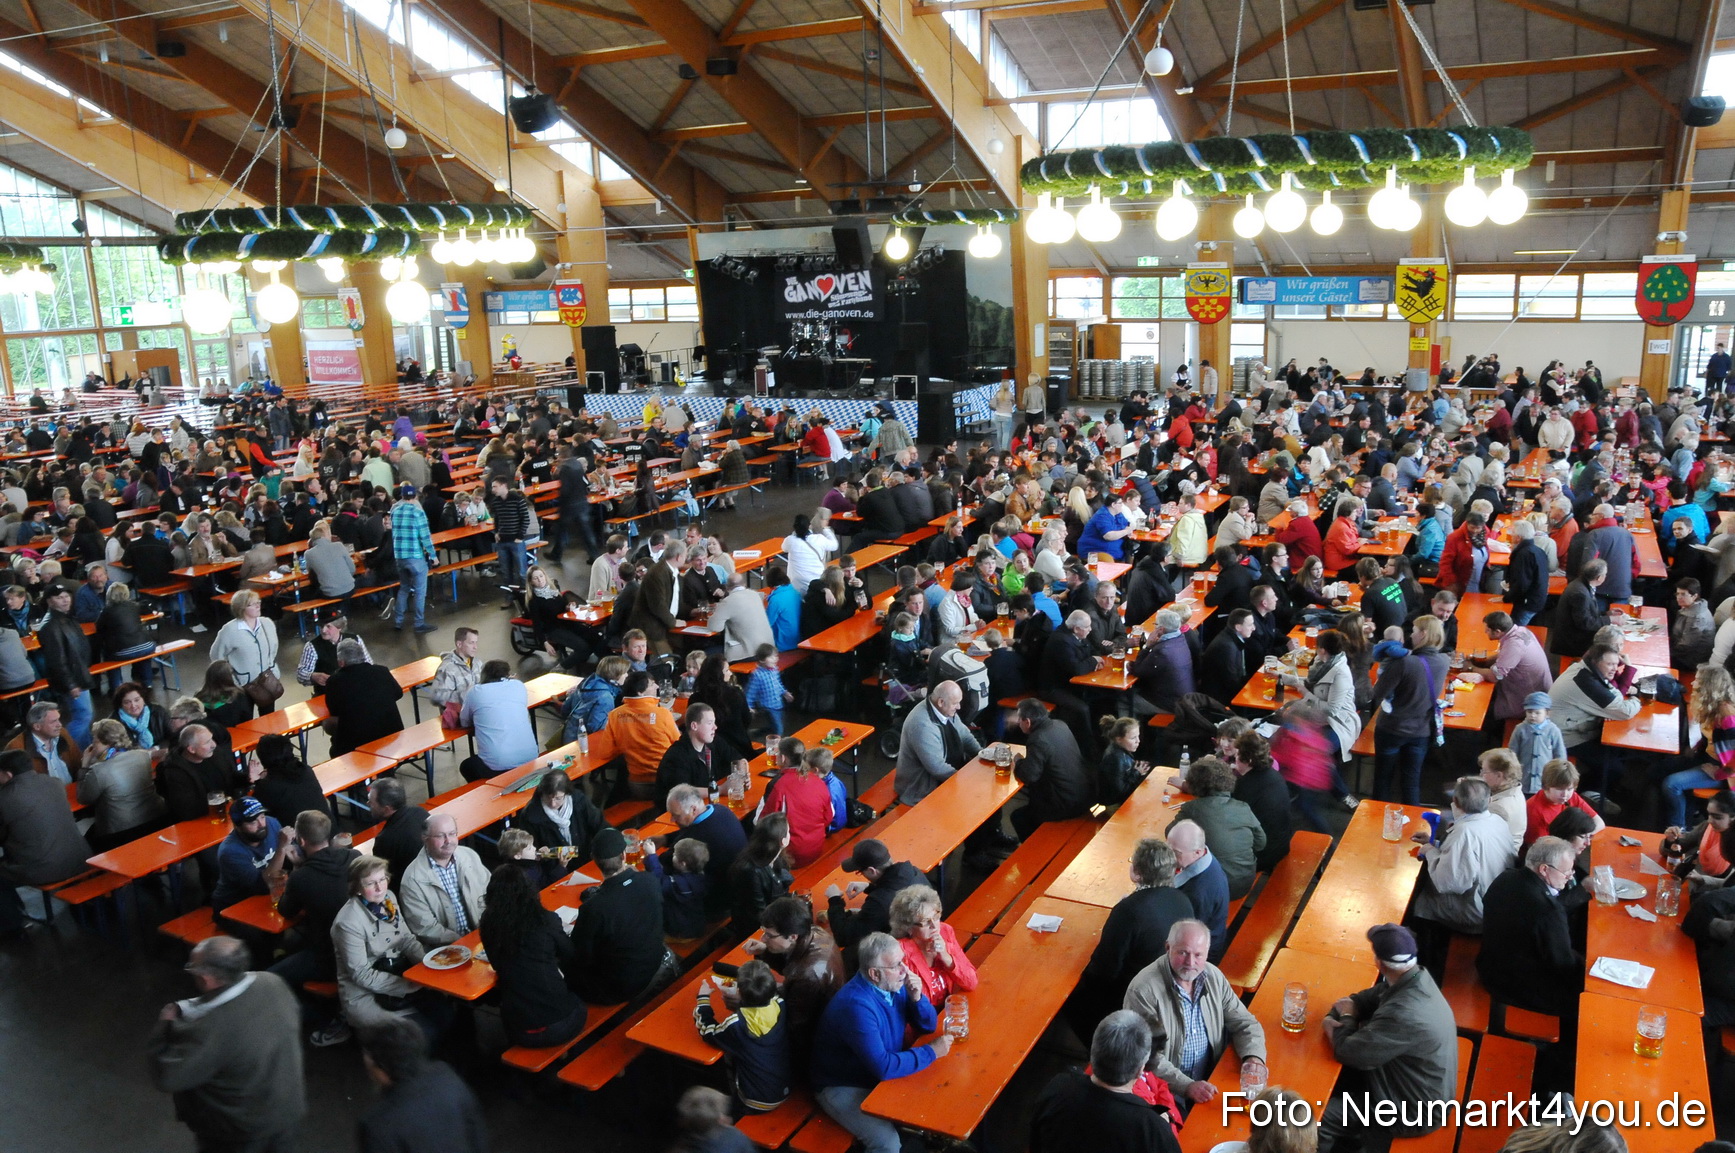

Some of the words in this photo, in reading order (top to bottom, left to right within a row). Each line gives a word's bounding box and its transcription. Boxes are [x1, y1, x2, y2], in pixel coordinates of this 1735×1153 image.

[1286, 279, 1307, 289] Wir
[1309, 277, 1349, 295] grüßen
[1282, 293, 1315, 303] unsere
[1318, 291, 1353, 303] Gäste!
[785, 309, 874, 320] www.die-ganoven.de
[313, 355, 344, 364] HERZLICH
[315, 366, 357, 375] WILLKOMMEN
